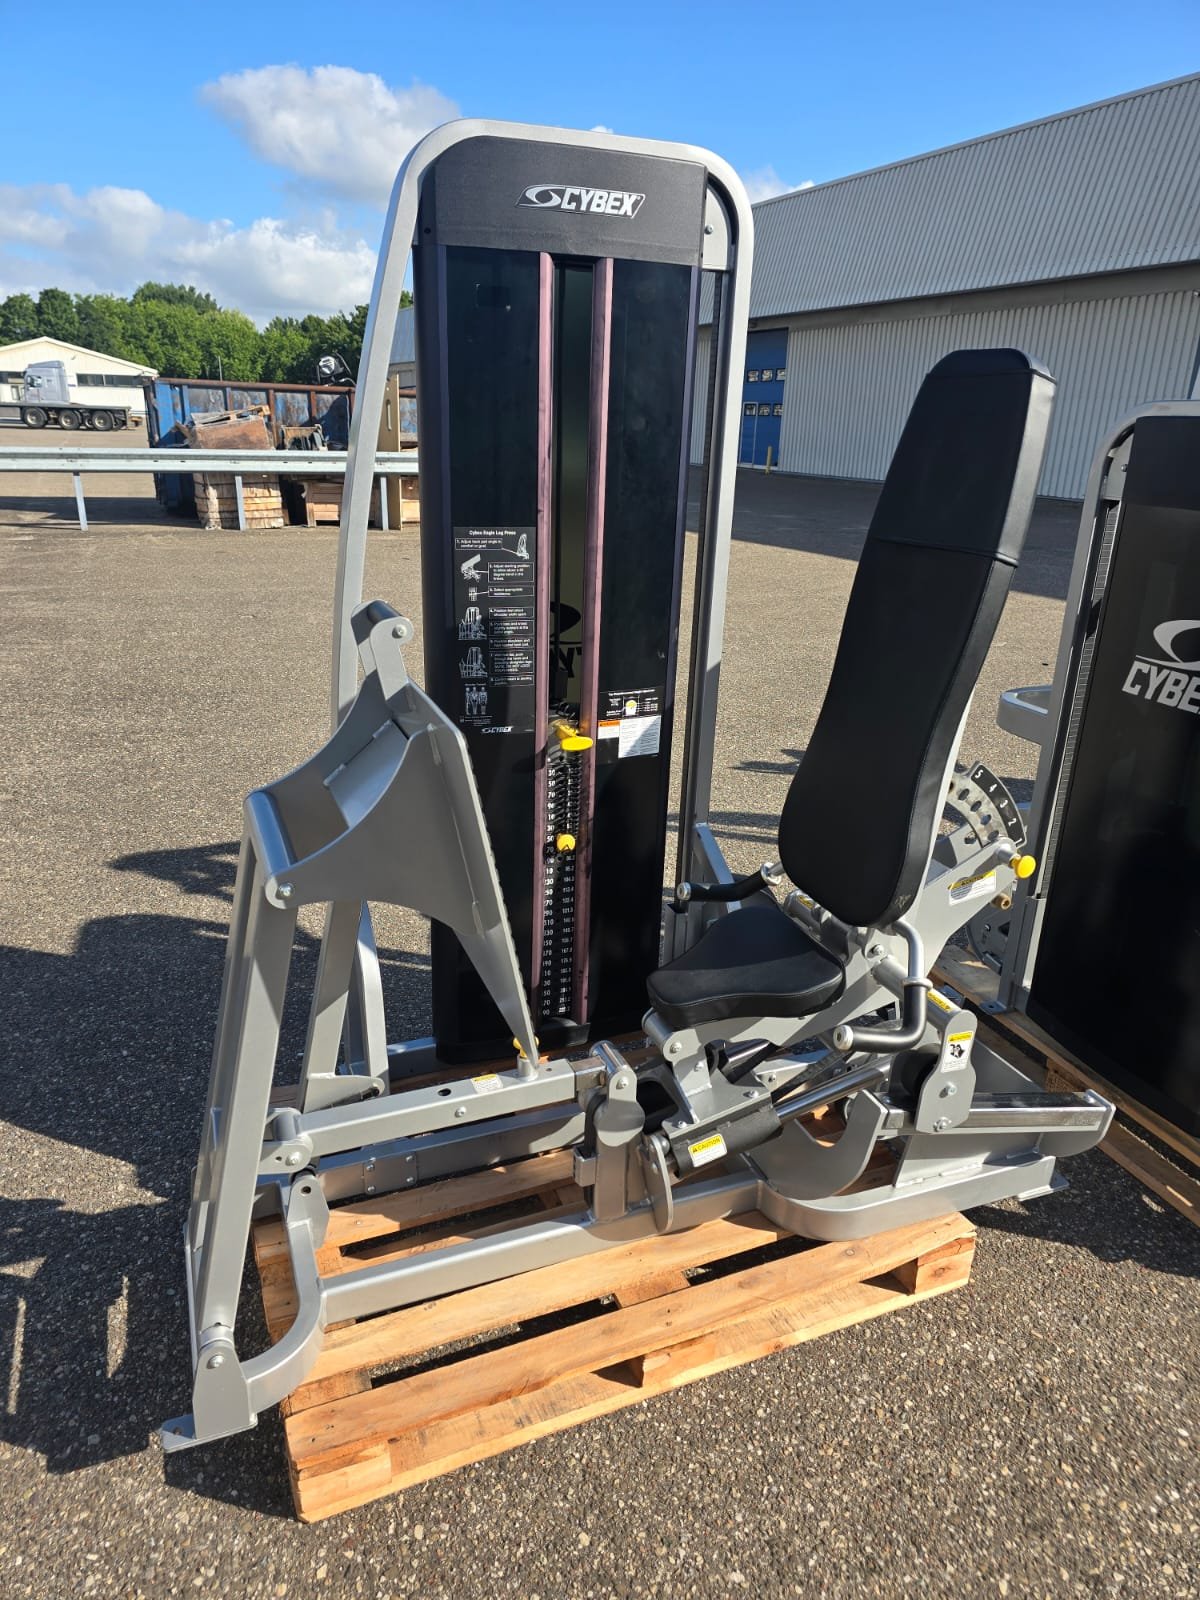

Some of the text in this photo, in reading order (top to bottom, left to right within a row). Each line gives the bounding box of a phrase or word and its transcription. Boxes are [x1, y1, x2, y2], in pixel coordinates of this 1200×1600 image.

[560, 187, 637, 216] CYBEX
[1122, 660, 1200, 714] CYBE
[974, 769, 984, 779] 5
[989, 783, 998, 792] 4
[1000, 800, 1008, 808] 3
[1007, 817, 1017, 827] 2
[698, 1137, 720, 1150] CAUTION
